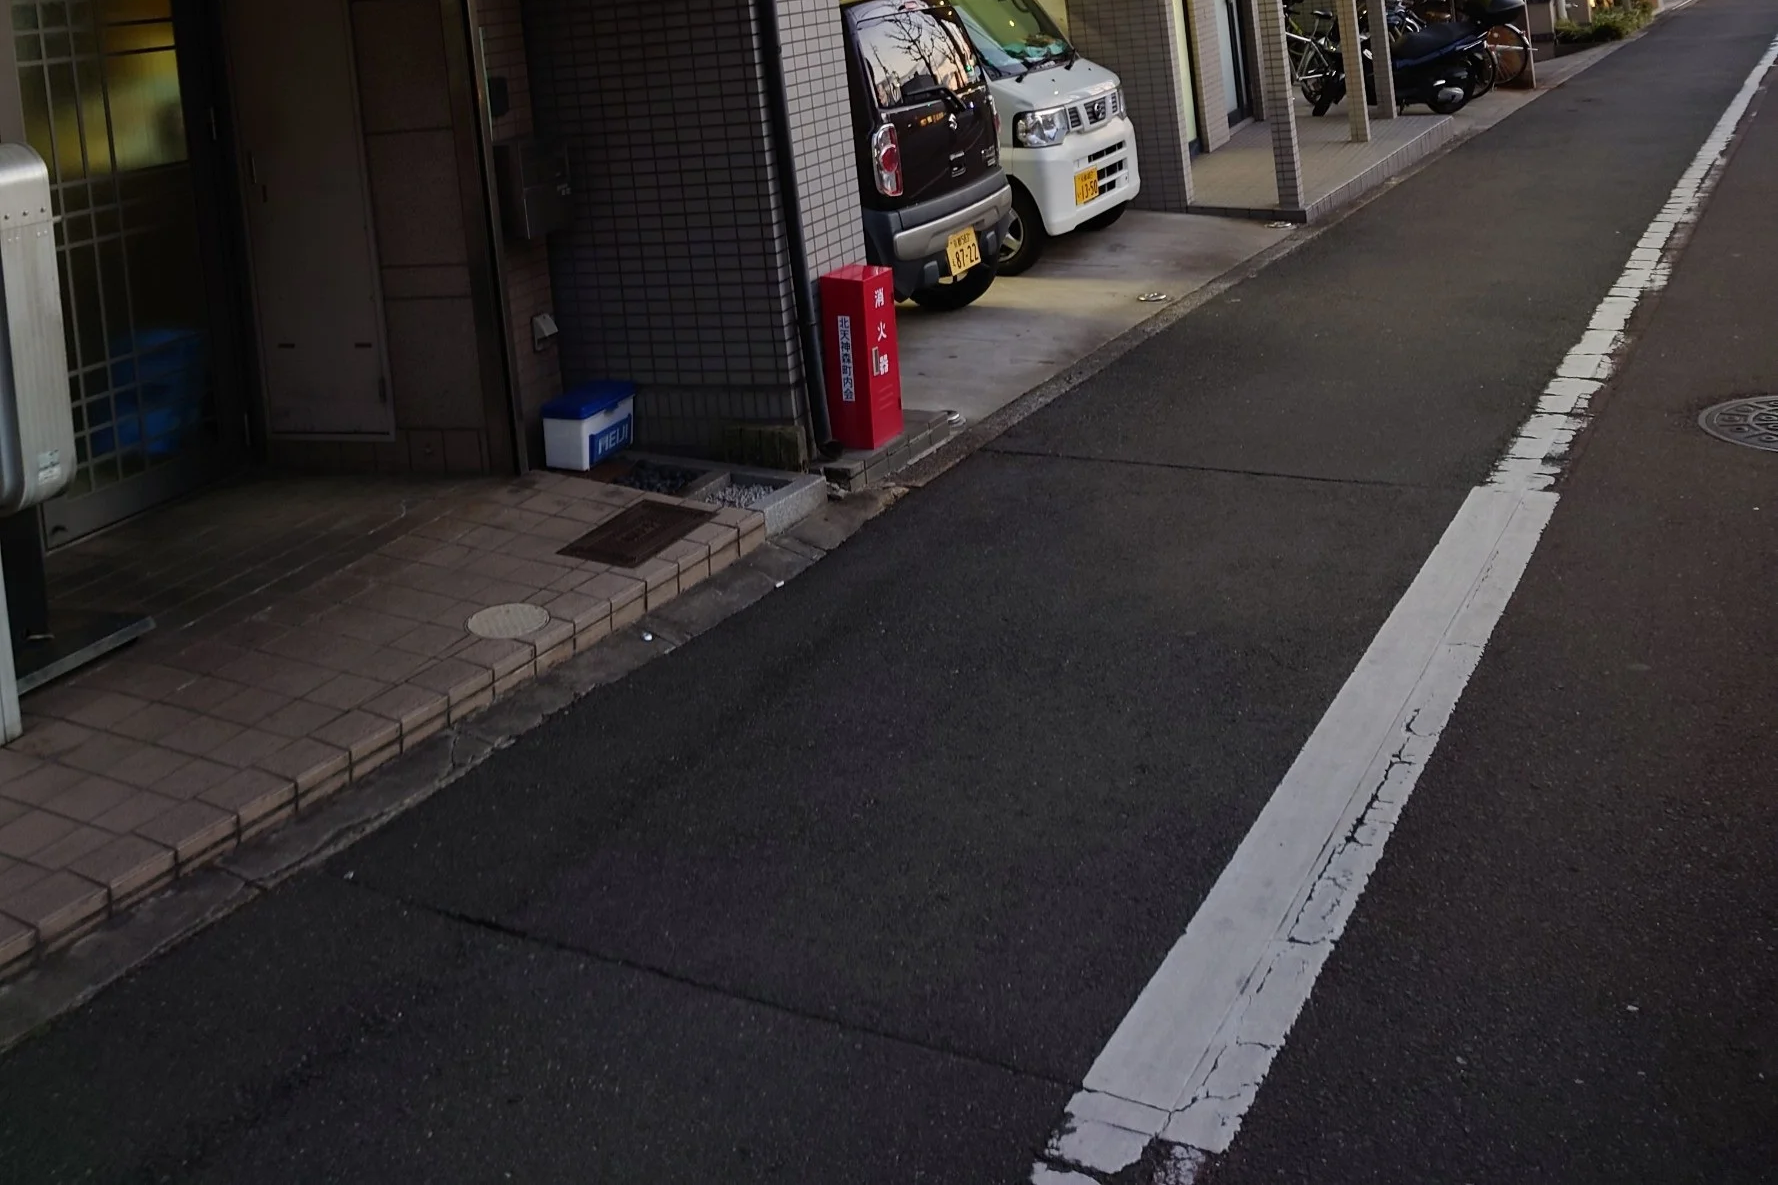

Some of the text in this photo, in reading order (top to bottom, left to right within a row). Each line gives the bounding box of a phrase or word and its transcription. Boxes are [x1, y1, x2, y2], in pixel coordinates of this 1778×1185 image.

[955, 242, 979, 269] 87-22
[839, 317, 854, 400] 北天神森町内会
[874, 286, 889, 376] 消火器
[598, 423, 629, 455] MEIJI
